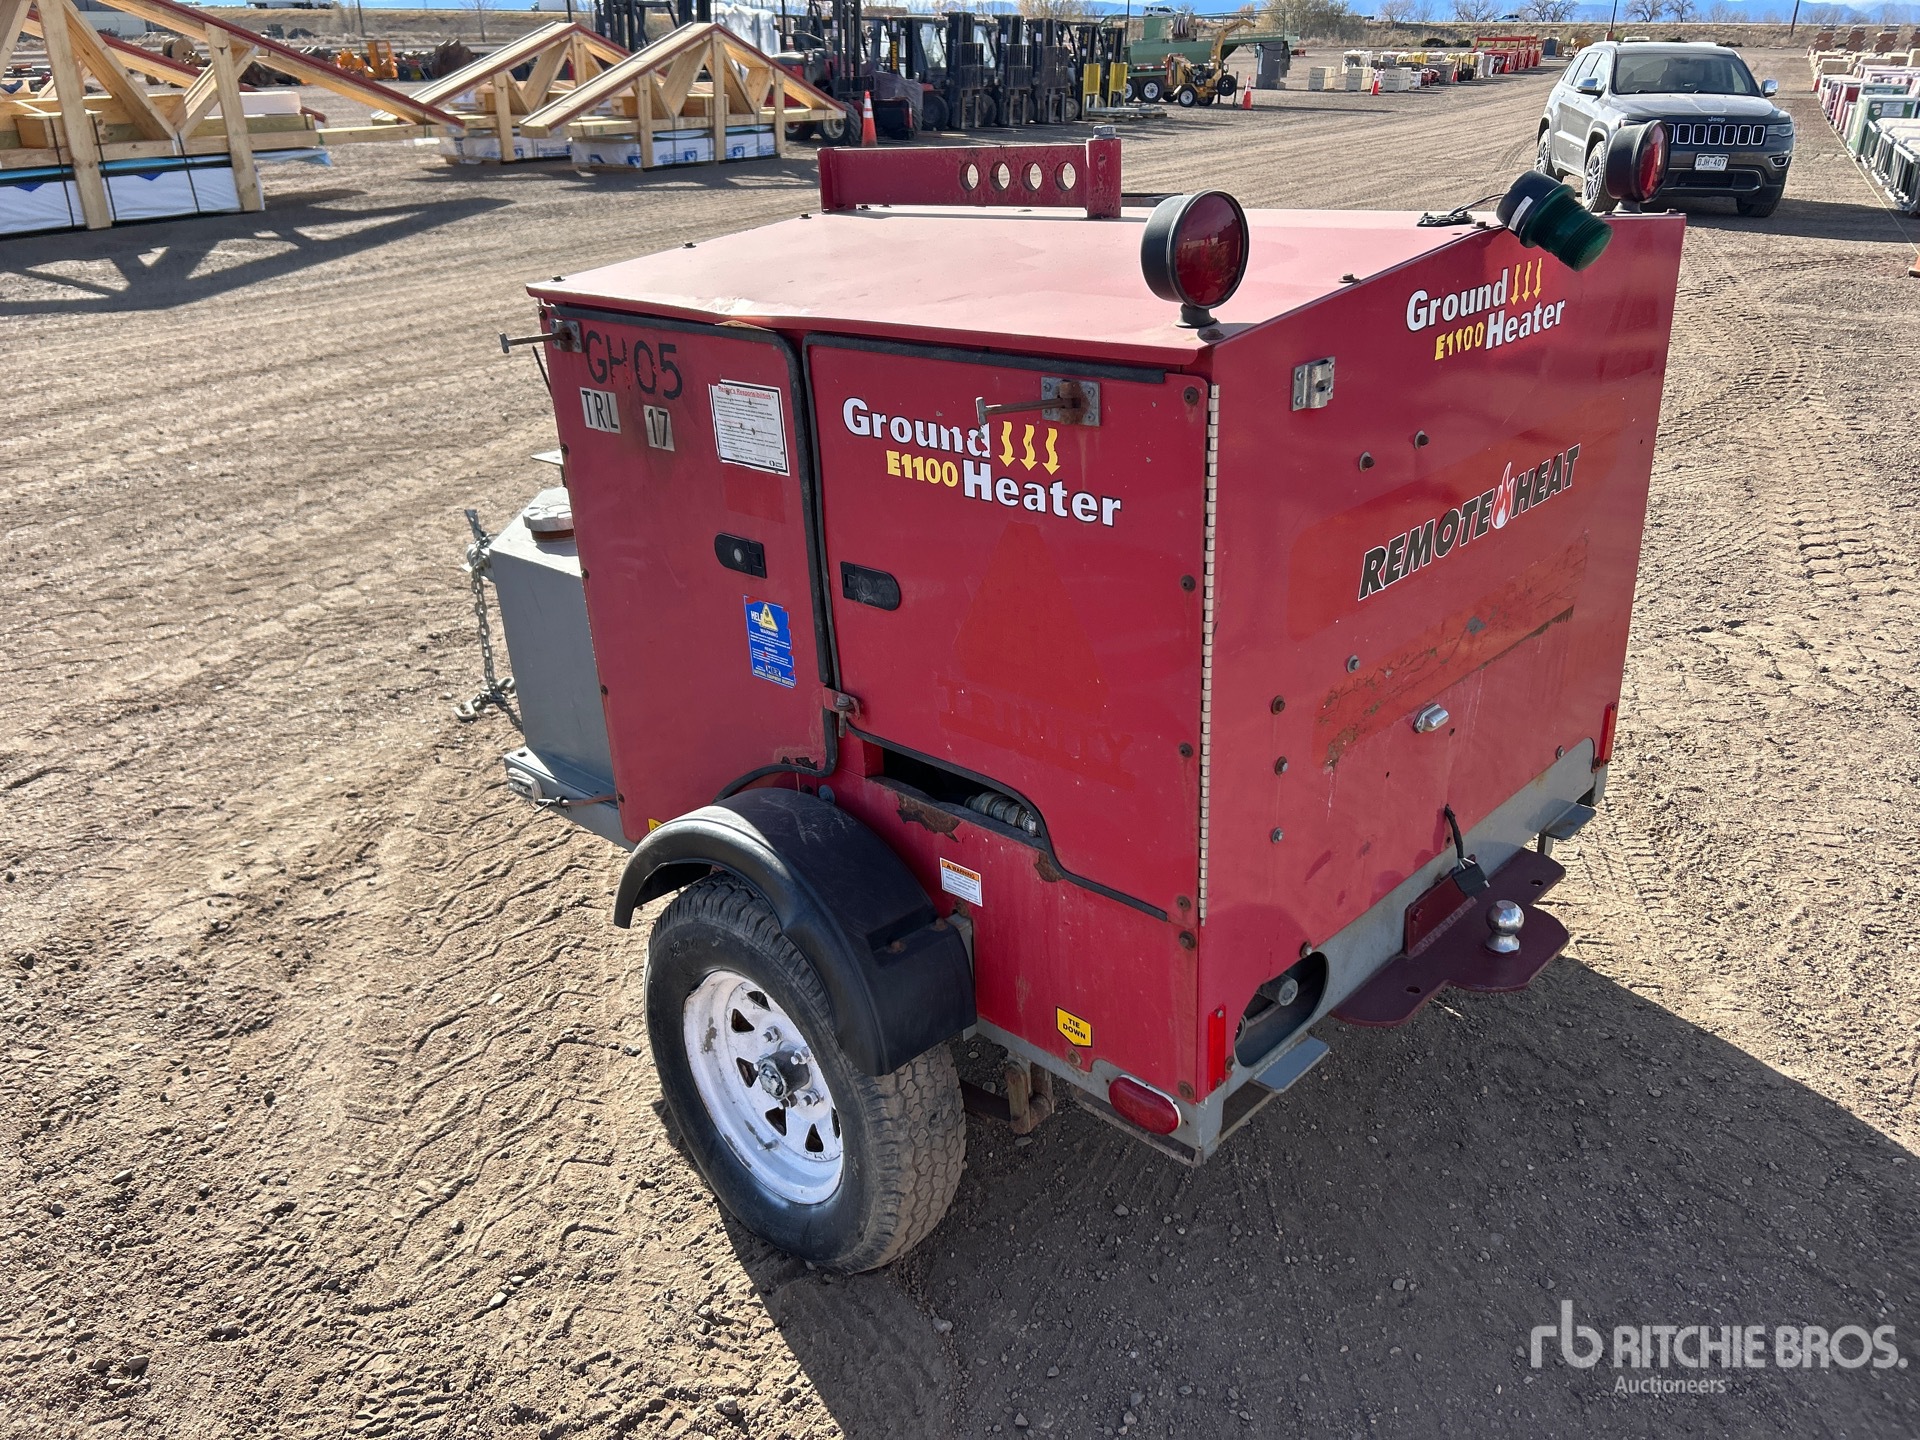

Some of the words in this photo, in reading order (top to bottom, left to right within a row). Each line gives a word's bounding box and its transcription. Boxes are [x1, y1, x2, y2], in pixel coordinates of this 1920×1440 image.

[1406, 268, 1509, 332] Ground
[1434, 321, 1485, 361] E1100
[1485, 300, 1566, 350] Heater
[581, 390, 619, 429] TRL
[648, 408, 668, 447] 17
[842, 396, 992, 459] Ground
[885, 449, 960, 488] E1100
[961, 458, 1122, 527] Heater
[1357, 487, 1496, 602] REMOTE
[1511, 442, 1581, 519] HEAT
[1062, 1023, 1086, 1040] DOWN
[1068, 1017, 1080, 1029] TIE
